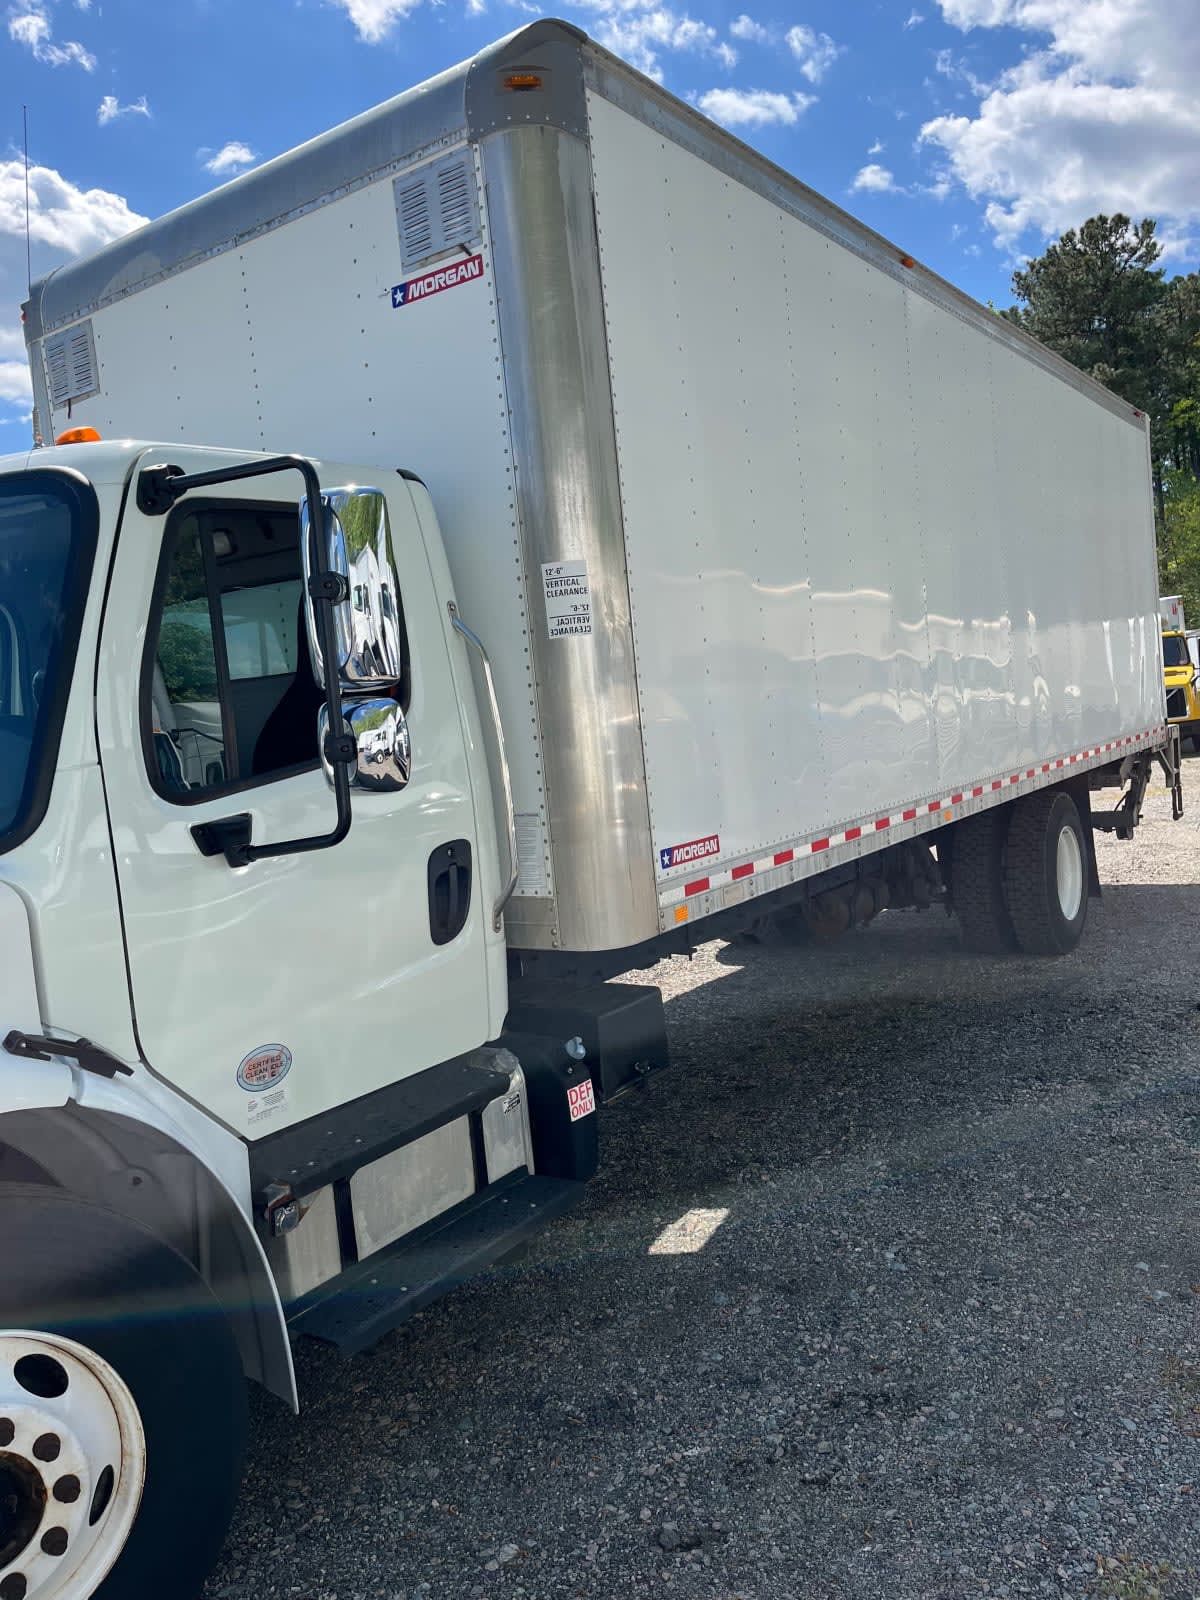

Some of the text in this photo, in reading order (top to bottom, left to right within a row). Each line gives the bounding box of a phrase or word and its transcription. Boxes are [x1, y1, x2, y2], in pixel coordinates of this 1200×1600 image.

[408, 260, 480, 300] MORGAN
[546, 579, 580, 589] VERTICAL
[546, 587, 589, 598] CLEARANCE
[673, 839, 718, 864] MORGAN
[248, 1054, 281, 1071] CERTIFIED
[246, 1067, 269, 1079] CLEAN
[568, 1080, 592, 1106] DEF
[571, 1098, 593, 1119] ONLY
